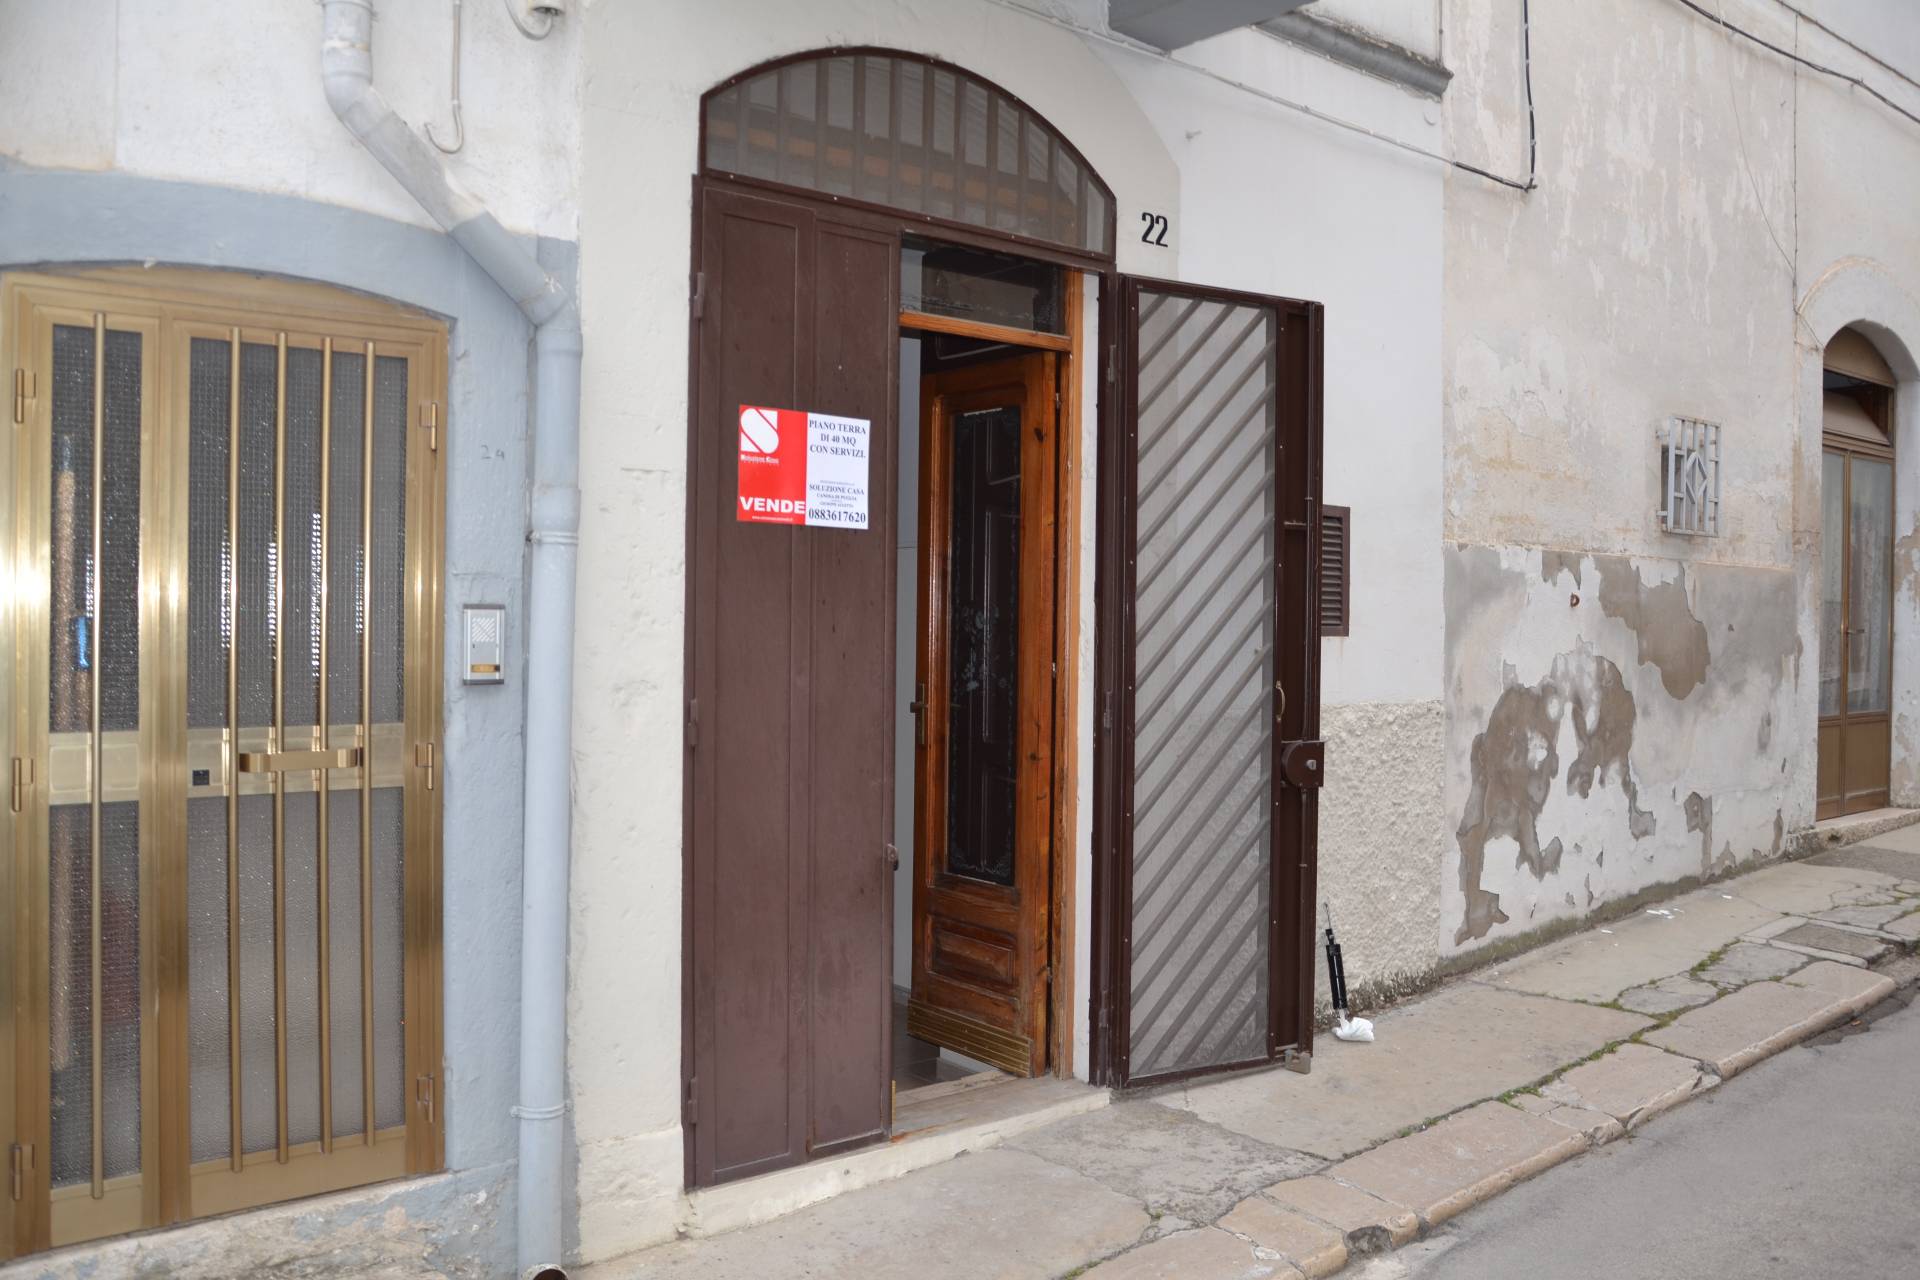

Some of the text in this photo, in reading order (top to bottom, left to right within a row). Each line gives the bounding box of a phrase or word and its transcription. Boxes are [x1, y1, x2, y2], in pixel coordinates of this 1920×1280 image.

[1142, 212, 1168, 248] 22
[809, 420, 866, 434] PIANO TERRA
[820, 433, 856, 447] DI 40 MQ
[810, 445, 828, 454] CON
[809, 484, 845, 493] SOLUZIONE
[740, 496, 805, 514] VENDE
[808, 508, 866, 523] 0883617620
